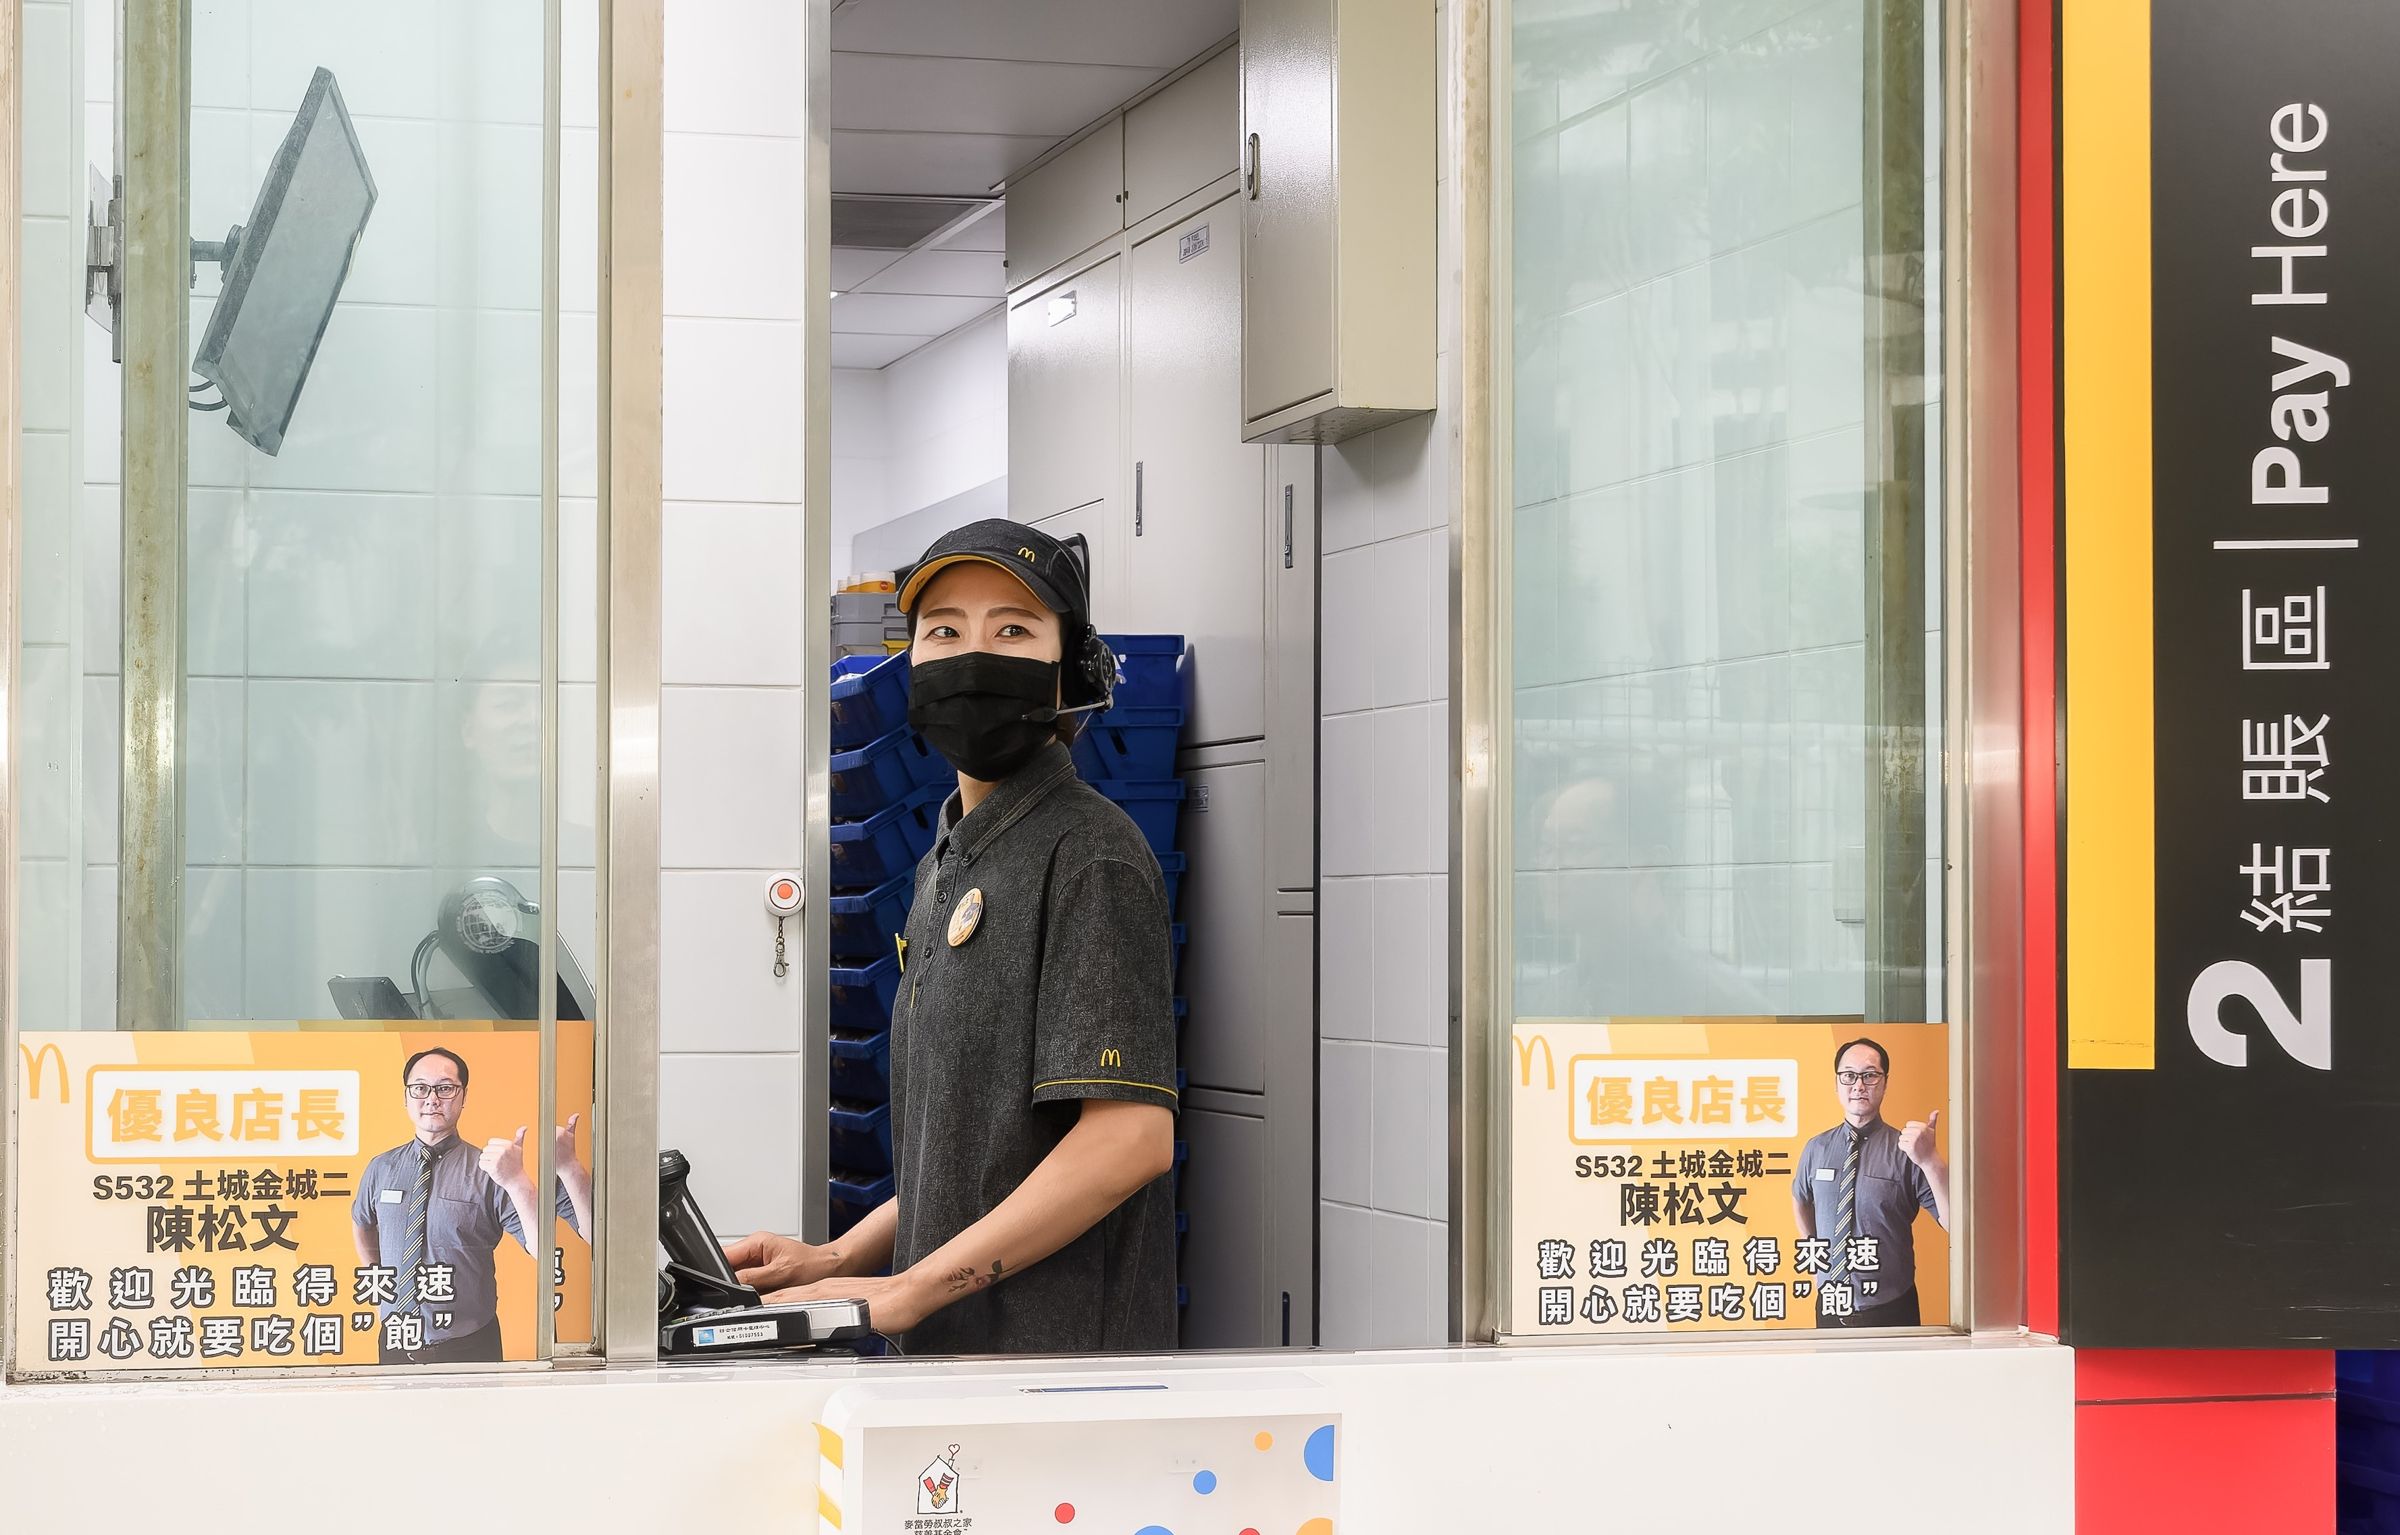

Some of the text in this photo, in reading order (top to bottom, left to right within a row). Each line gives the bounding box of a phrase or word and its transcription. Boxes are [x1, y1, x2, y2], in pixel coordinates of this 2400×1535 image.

[2251, 103, 2351, 504] Pay Here
[2187, 958, 2332, 1071] 2
[107, 1087, 346, 1144] 優良店長
[1586, 1075, 1786, 1126] 優良店長
[92, 1169, 352, 1201] S532 土城金城二
[1575, 1150, 1792, 1179] S532 土城金城二
[146, 1204, 299, 1253] 陳松文
[1620, 1182, 1749, 1227] 陳松文
[1538, 1237, 1880, 1278] 歡迎光臨得來速
[47, 1264, 457, 1311] 歡迎光臨得來速
